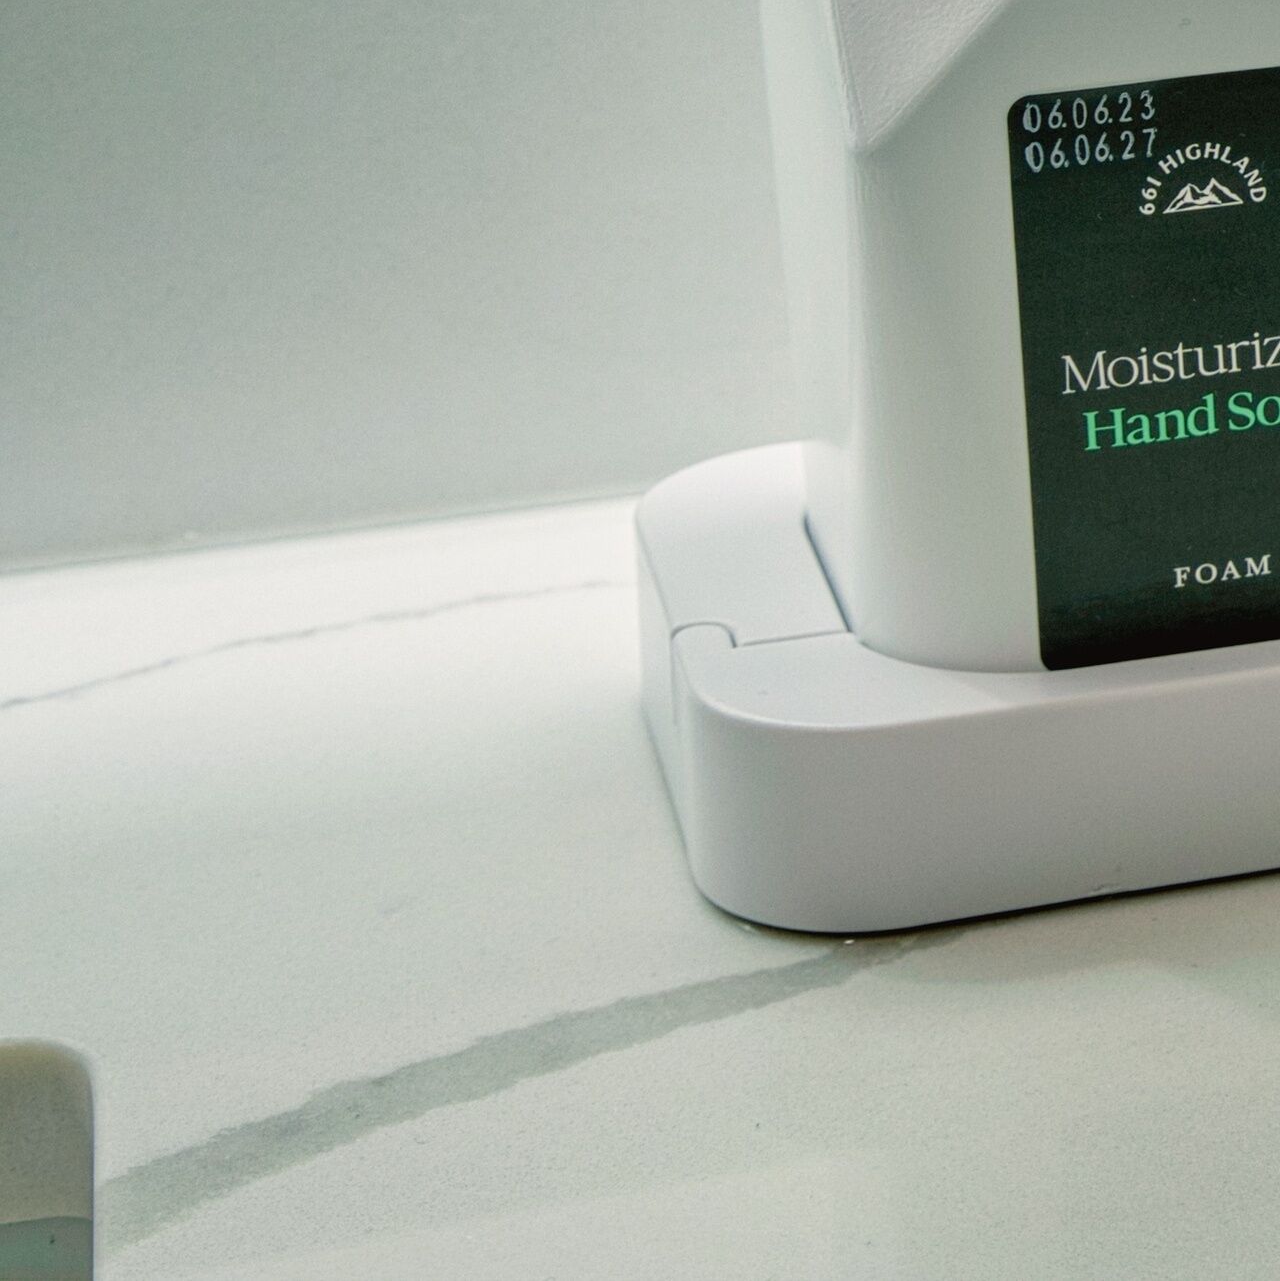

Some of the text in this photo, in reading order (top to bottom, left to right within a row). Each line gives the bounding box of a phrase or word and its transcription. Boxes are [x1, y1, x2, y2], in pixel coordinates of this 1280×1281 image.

[1022, 89, 1156, 134] 06.06.23
[1024, 127, 1158, 174] 06.06.27
[1139, 141, 1268, 216] 661 HIGHLAND
[1082, 392, 1219, 451] Hand
[1173, 554, 1272, 589] FOAM
